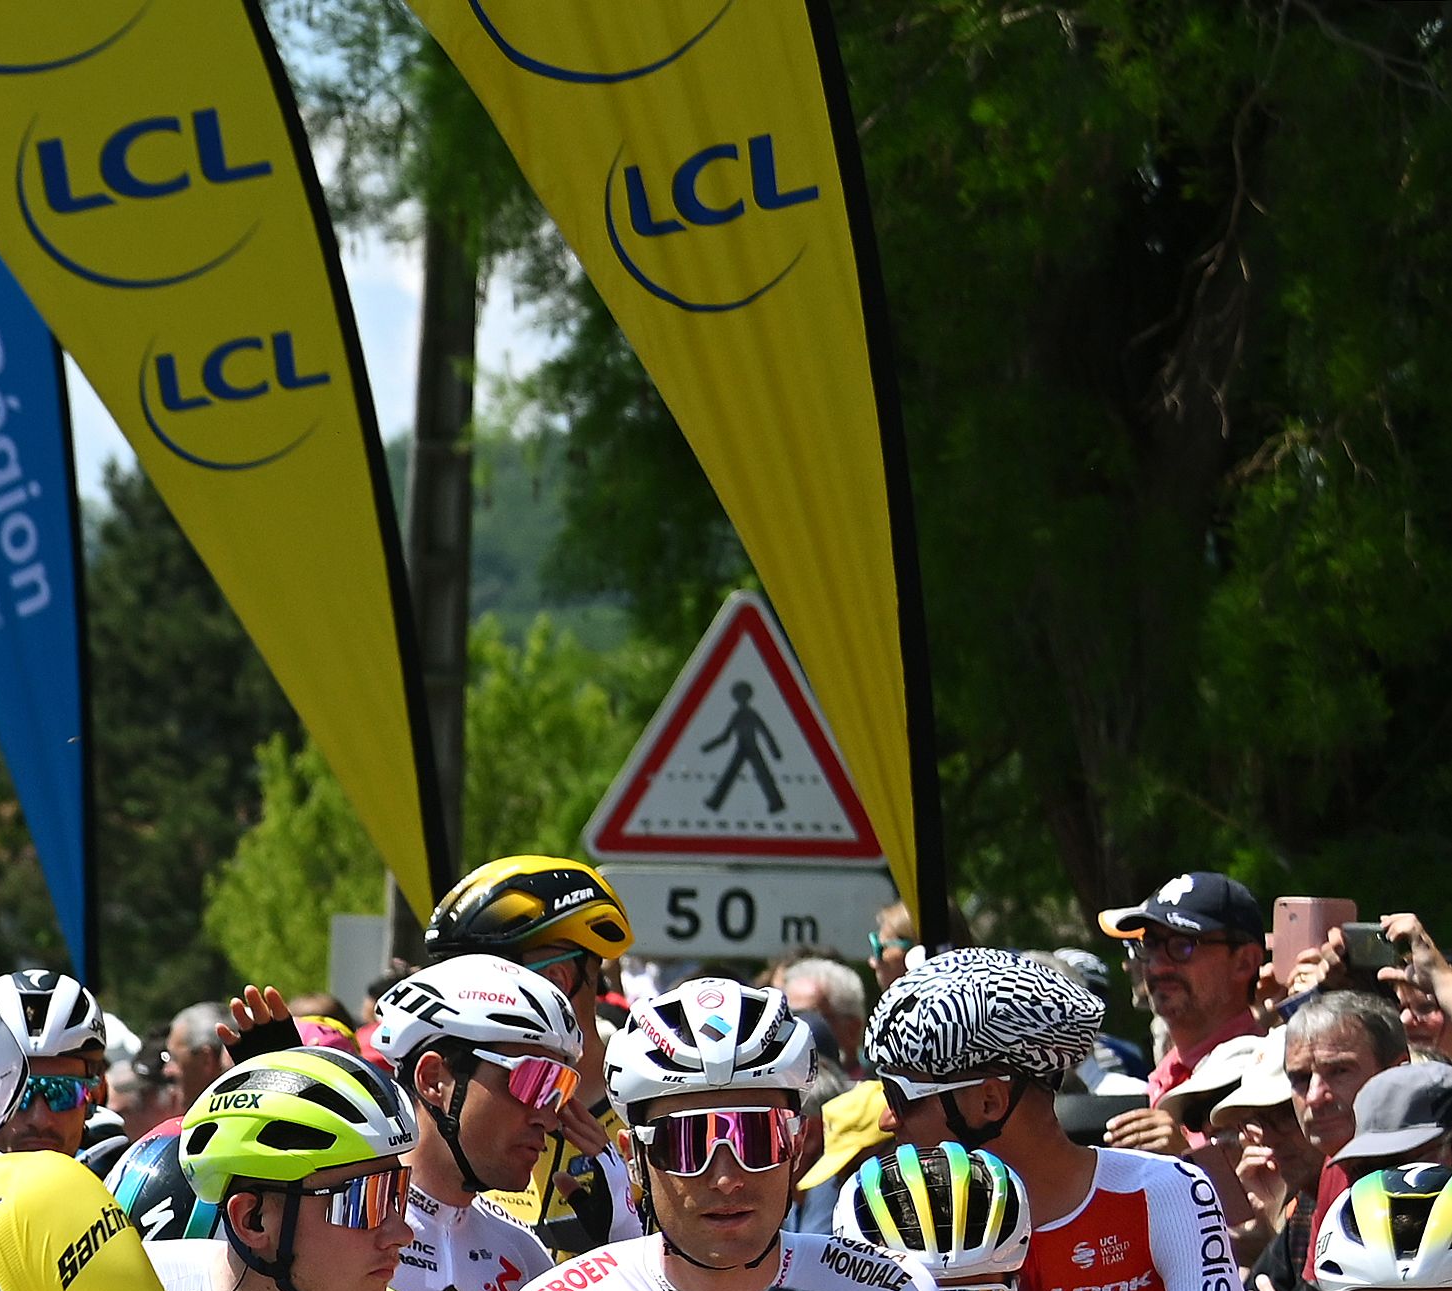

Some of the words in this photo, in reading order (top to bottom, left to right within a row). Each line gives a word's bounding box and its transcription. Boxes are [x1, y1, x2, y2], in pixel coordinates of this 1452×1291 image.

[37, 108, 272, 214] LCL
[624, 134, 819, 237] LCL
[154, 331, 331, 412] LCL
[553, 885, 594, 911] LAZER
[664, 885, 755, 941] 50
[781, 914, 820, 943] m
[384, 984, 460, 1028] HJC
[457, 990, 518, 1007] CITROËN
[637, 1014, 676, 1058] CITROËN
[208, 1091, 264, 1113] uvex
[388, 1132, 413, 1146] uvex
[1099, 1237, 1119, 1246] UCI
[1100, 1242, 1131, 1256] WORLD
[1101, 1252, 1126, 1266] TEAM
